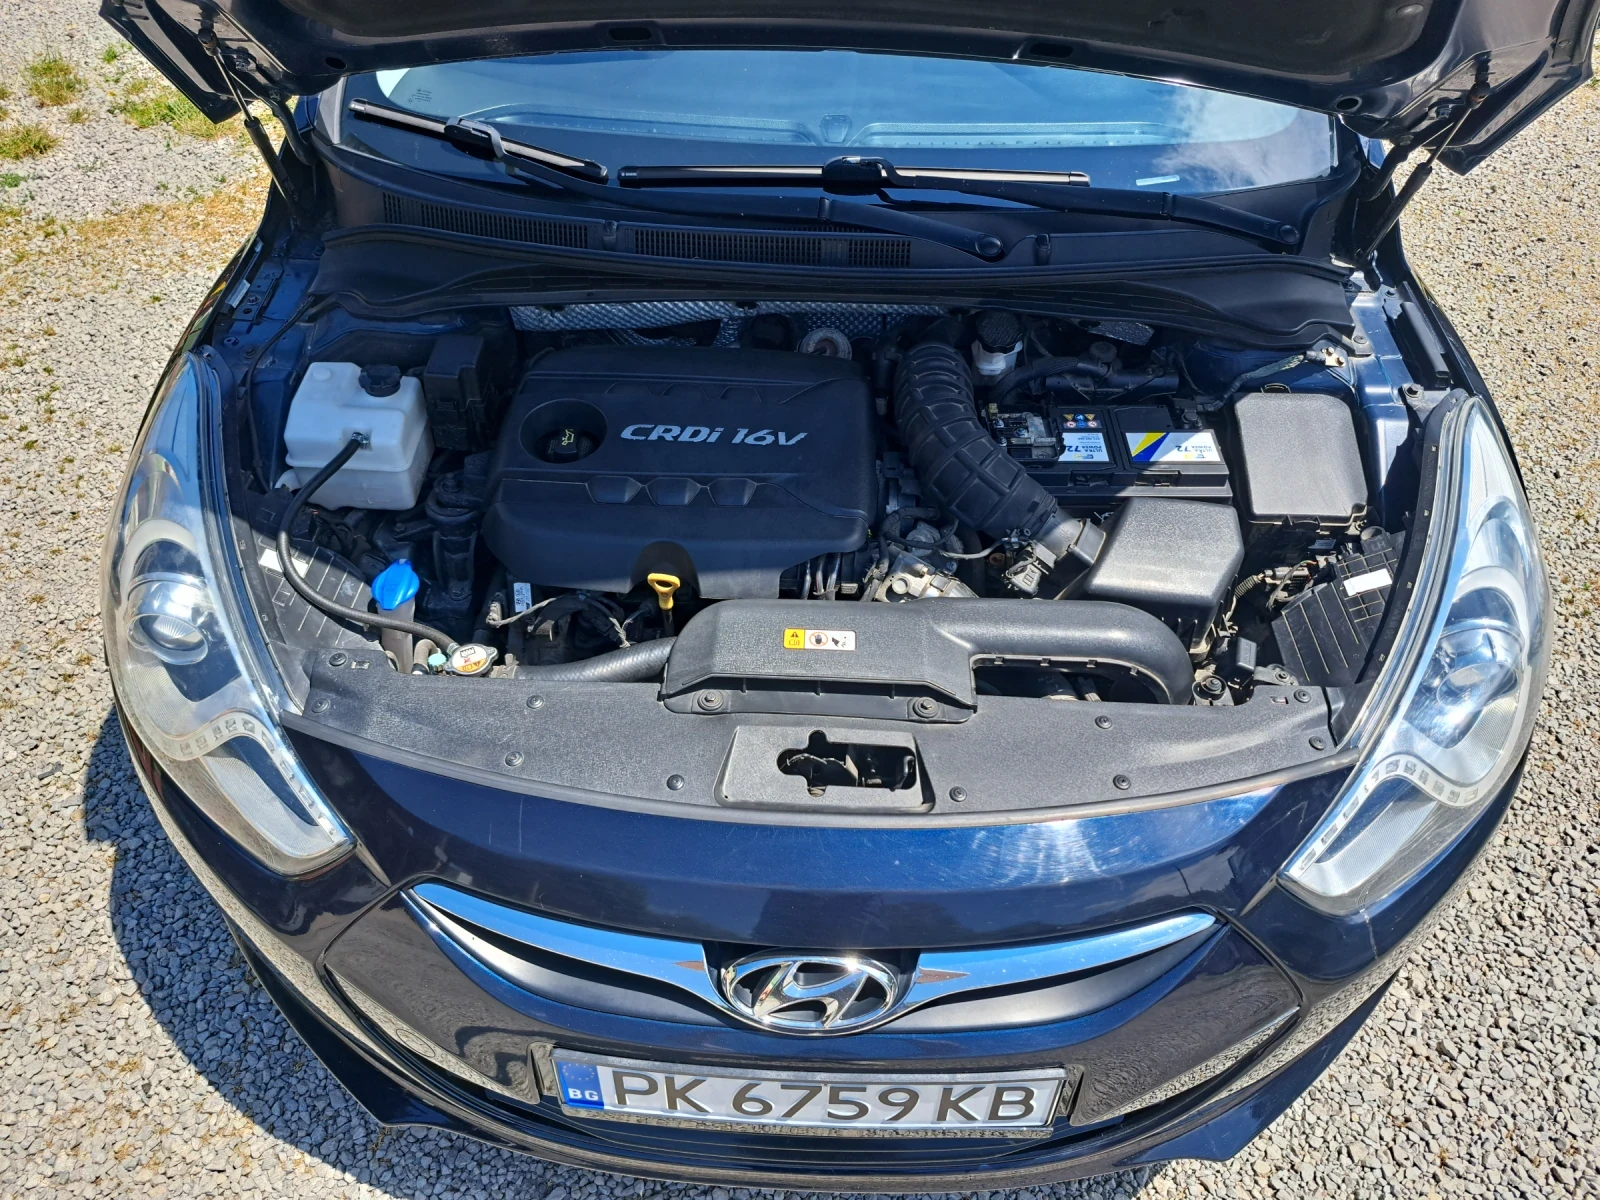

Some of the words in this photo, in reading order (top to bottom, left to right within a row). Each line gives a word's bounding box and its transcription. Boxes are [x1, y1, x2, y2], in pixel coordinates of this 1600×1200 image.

[620, 424, 724, 443] CRDi
[731, 428, 808, 446] 16V
[1065, 445, 1082, 453] 72
[1175, 445, 1192, 453] 72
[568, 1087, 599, 1102] BG
[611, 1069, 717, 1114] PK
[732, 1082, 921, 1122] 6759
[935, 1086, 1037, 1123] KB
